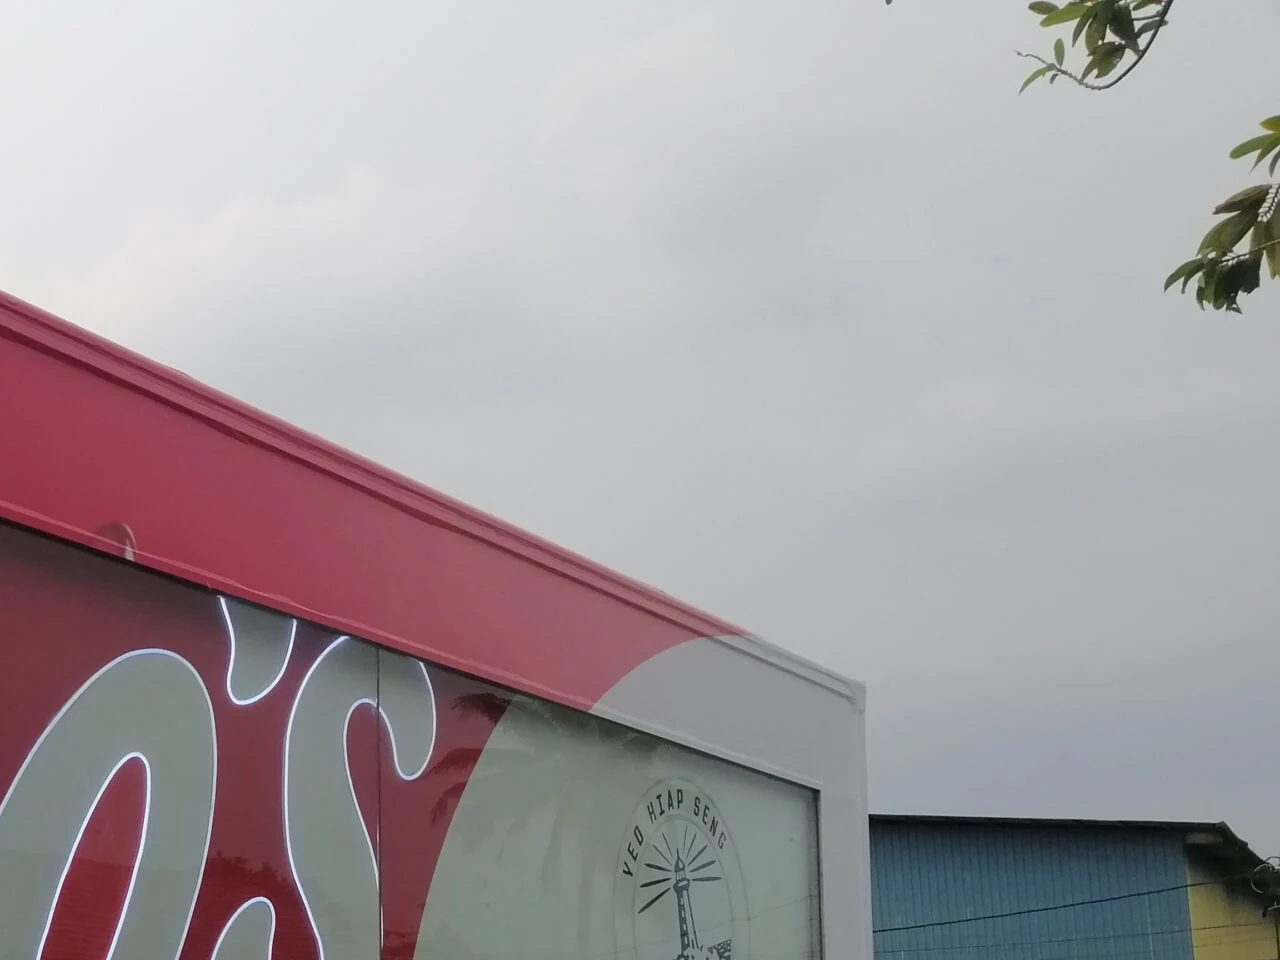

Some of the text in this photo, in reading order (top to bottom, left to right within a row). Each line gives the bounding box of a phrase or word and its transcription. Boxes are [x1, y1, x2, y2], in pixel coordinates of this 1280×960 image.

[622, 787, 727, 878] YEO HIAP SENG
